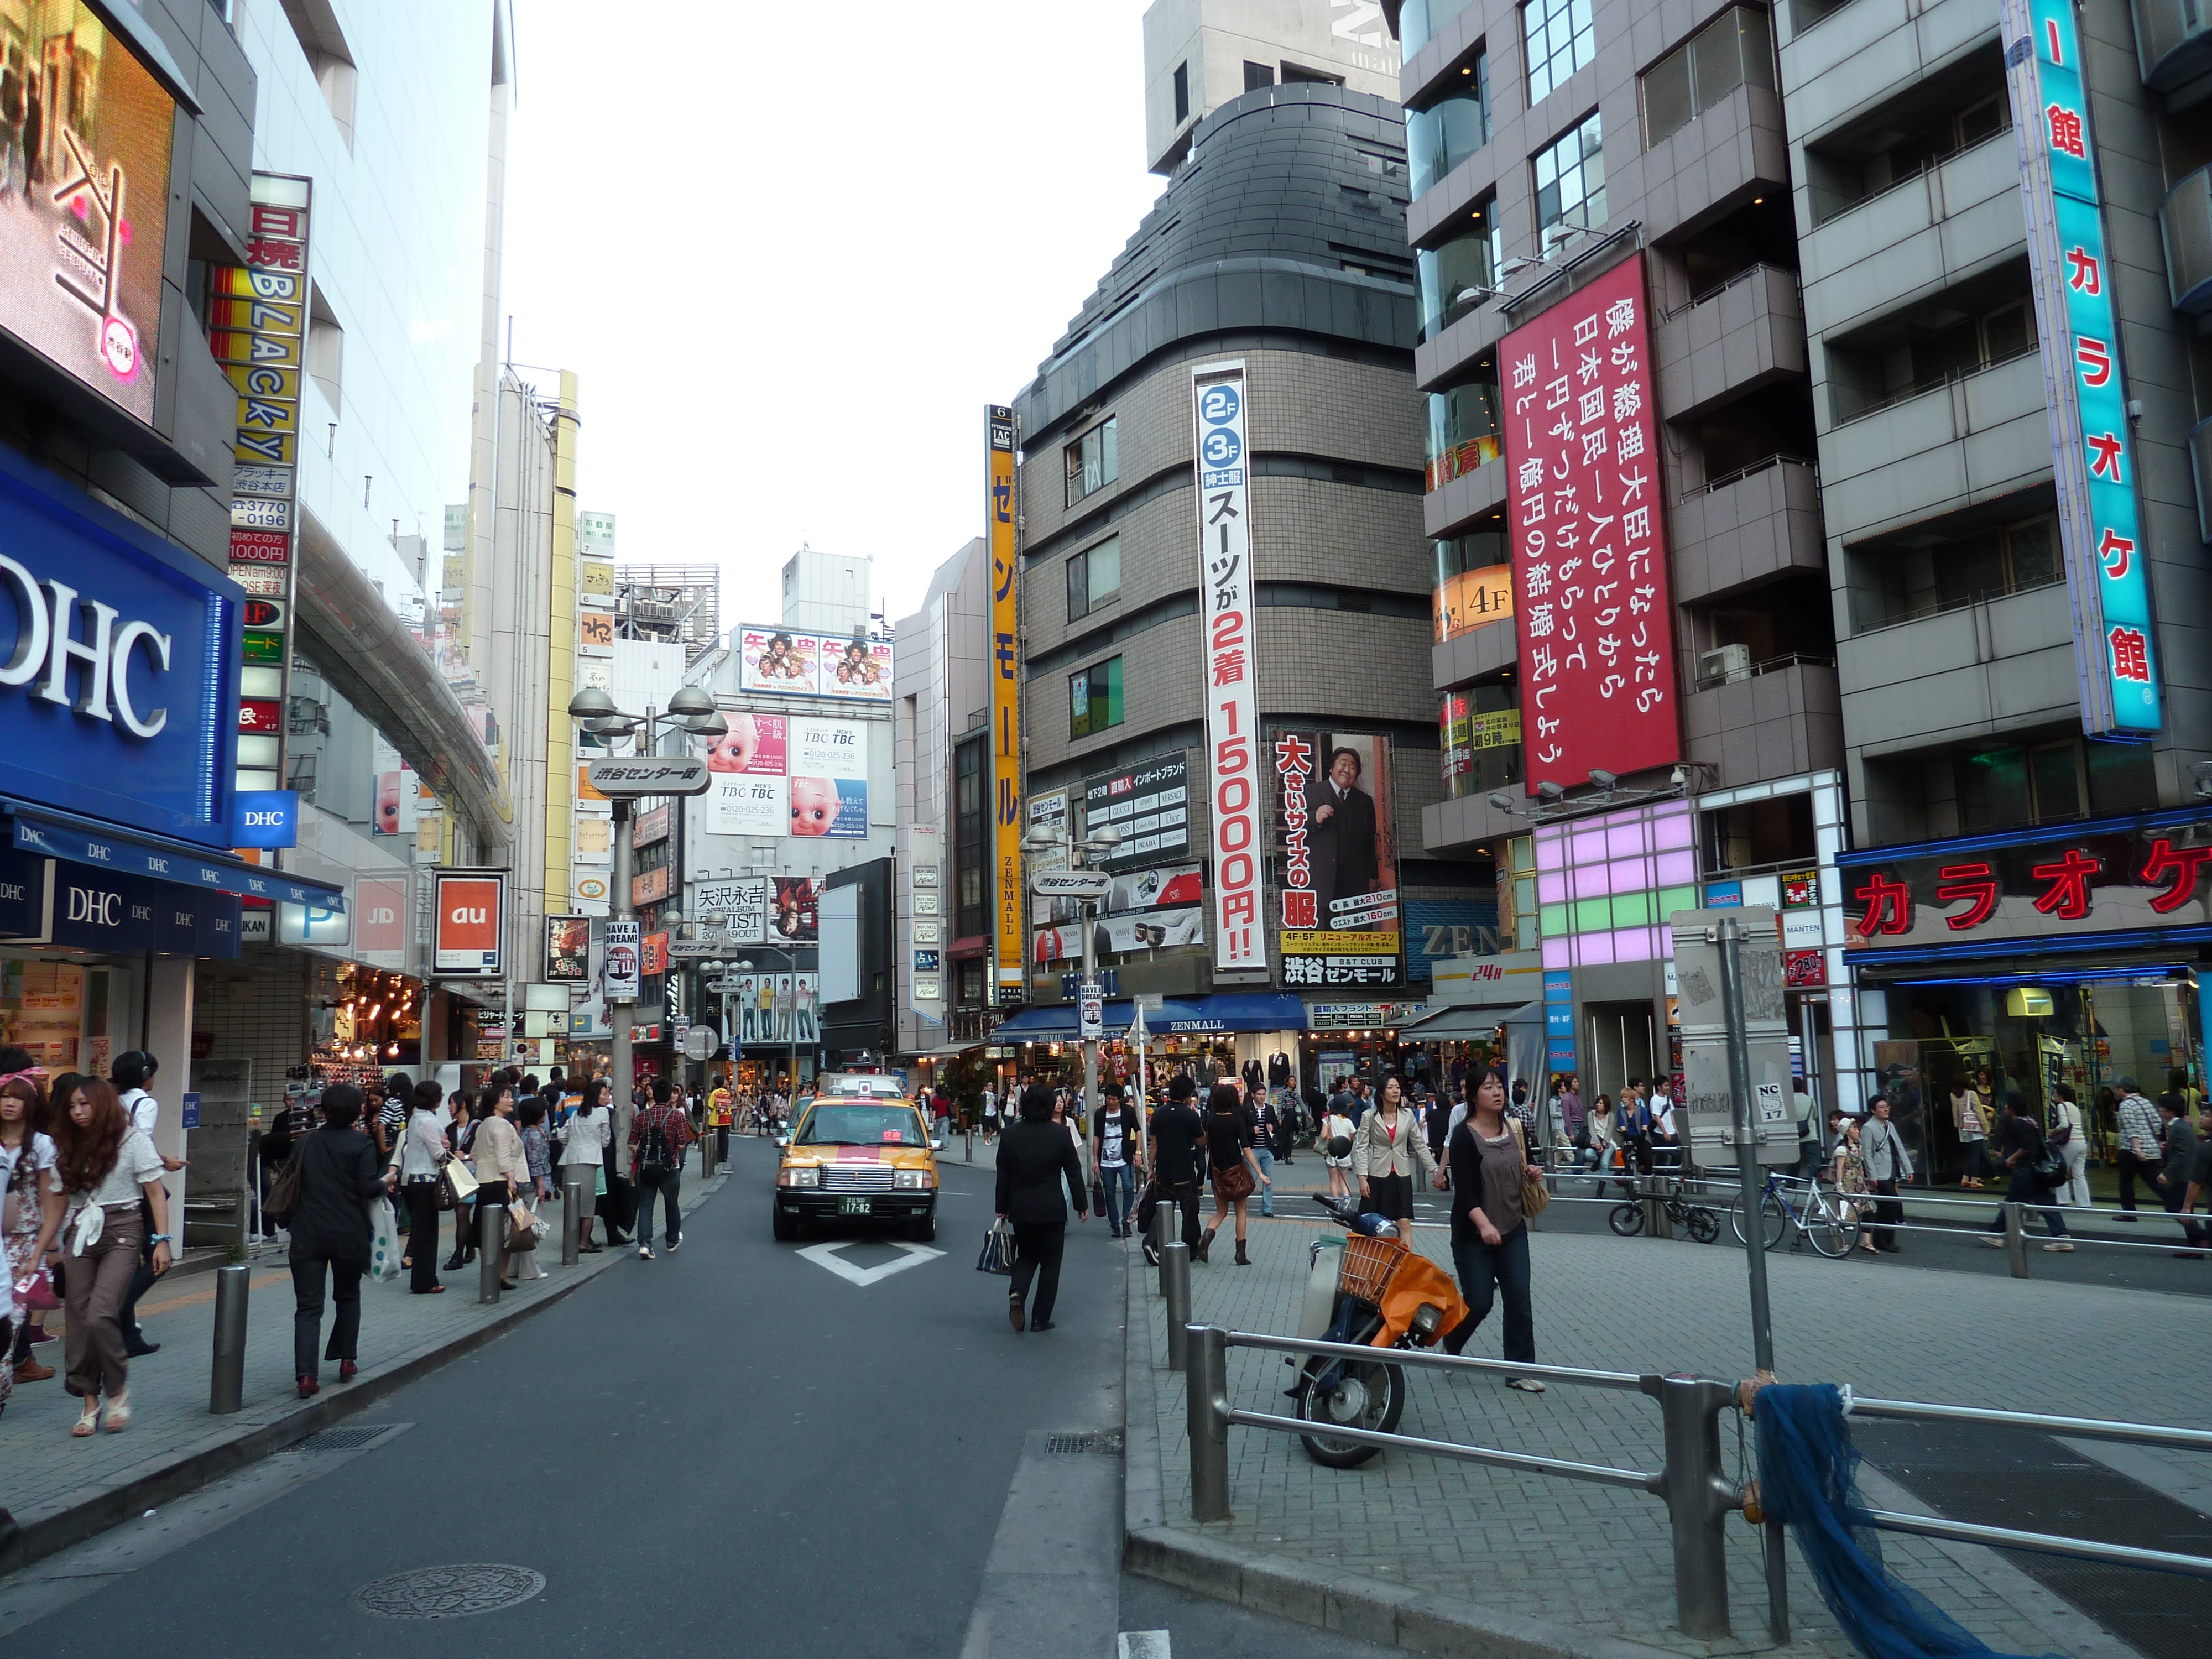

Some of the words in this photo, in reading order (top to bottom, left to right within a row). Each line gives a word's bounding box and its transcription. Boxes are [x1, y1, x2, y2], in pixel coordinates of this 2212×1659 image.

[998, 408, 1005, 417] 6
[1206, 393, 1235, 419] 2F
[1207, 435, 1237, 460] 3F
[2065, 246, 2150, 684] カラオケ館
[234, 467, 289, 479] ブラッキー
[1205, 470, 1240, 487] 紳士服
[234, 479, 286, 493] 渋谷本店
[247, 500, 286, 513] 3770
[1546, 338, 1587, 670] 一円ずつだけもらって
[1573, 314, 1626, 699] 日本国民一人ひとりから
[1605, 297, 1663, 713] 僕が総理大臣になったら
[586, 519, 613, 530] 不動産
[232, 531, 283, 544] 初めての方
[230, 545, 284, 560] 1000円
[1513, 353, 1562, 764] 君と一億円の結婚式しよう
[262, 581, 281, 594] 深夜
[1469, 585, 1509, 614] 4F
[0, 557, 171, 738] DHC
[744, 632, 767, 653] 矢
[822, 640, 846, 660] 矢
[993, 476, 1018, 827] ゼンモール
[1485, 717, 1508, 725] 北の家族
[1485, 722, 1520, 732] 井の頭通り店
[804, 732, 828, 743] TBC
[833, 734, 856, 745] TBC
[810, 750, 855, 760] 0120-025-236
[594, 767, 701, 780] 渋谷センター街
[1087, 785, 1108, 800] 地下2階
[1111, 778, 1131, 795] 直輸入
[1133, 761, 1185, 786] インポートブランド
[721, 786, 747, 797] TBC
[751, 788, 775, 799] TBC
[1162, 790, 1183, 802] VERSACE
[727, 805, 774, 814] 0120-025-236
[1033, 797, 1061, 815] 渋谷ゼンモール
[1113, 805, 1130, 816] GUCCI
[245, 812, 284, 825] DHC
[1166, 813, 1180, 824] Dior
[1136, 821, 1147, 830] Calvin
[20, 826, 45, 846] DHC
[1138, 839, 1156, 849] PRADA
[88, 843, 111, 860] DHC
[148, 857, 169, 873] DHC
[201, 869, 220, 883] DHC
[1039, 878, 1108, 887] 渋谷センター街
[0, 883, 25, 901] DHC
[249, 879, 267, 892] DHC
[1854, 838, 2212, 935] カラオケ
[290, 888, 305, 901] DHC
[698, 885, 764, 907] 矢沢永吉
[1004, 857, 1014, 935] ZENMALL
[1708, 895, 1739, 906] カラオケ館
[67, 886, 122, 926] DHC
[132, 905, 152, 920] DHC
[176, 912, 194, 927] DHC
[452, 907, 486, 924] au
[1333, 917, 1351, 927] ウエスト
[216, 919, 232, 933] DHC
[607, 925, 629, 933] HAVE
[1114, 928, 1130, 937] ARMANI
[1787, 925, 1820, 933] MANTEN
[607, 935, 637, 943] DREAM!
[917, 952, 938, 963] 占い
[607, 960, 635, 974] 富山
[1284, 957, 1324, 984] 渋谷
[1472, 964, 1503, 982] 24H
[1326, 968, 1396, 983] ゼンモール
[1314, 1004, 1372, 1013] 直輸入ブランド
[1083, 1011, 1102, 1021] 新潟
[575, 1016, 586, 1030] P
[1171, 1020, 1224, 1031] ZENMALL
[1038, 1034, 1065, 1044] ZENMALL
[1759, 1085, 1778, 1096] NC
[185, 1101, 197, 1110] DHC
[1765, 1110, 1782, 1119] 17
[846, 1203, 870, 1213] 17-82
